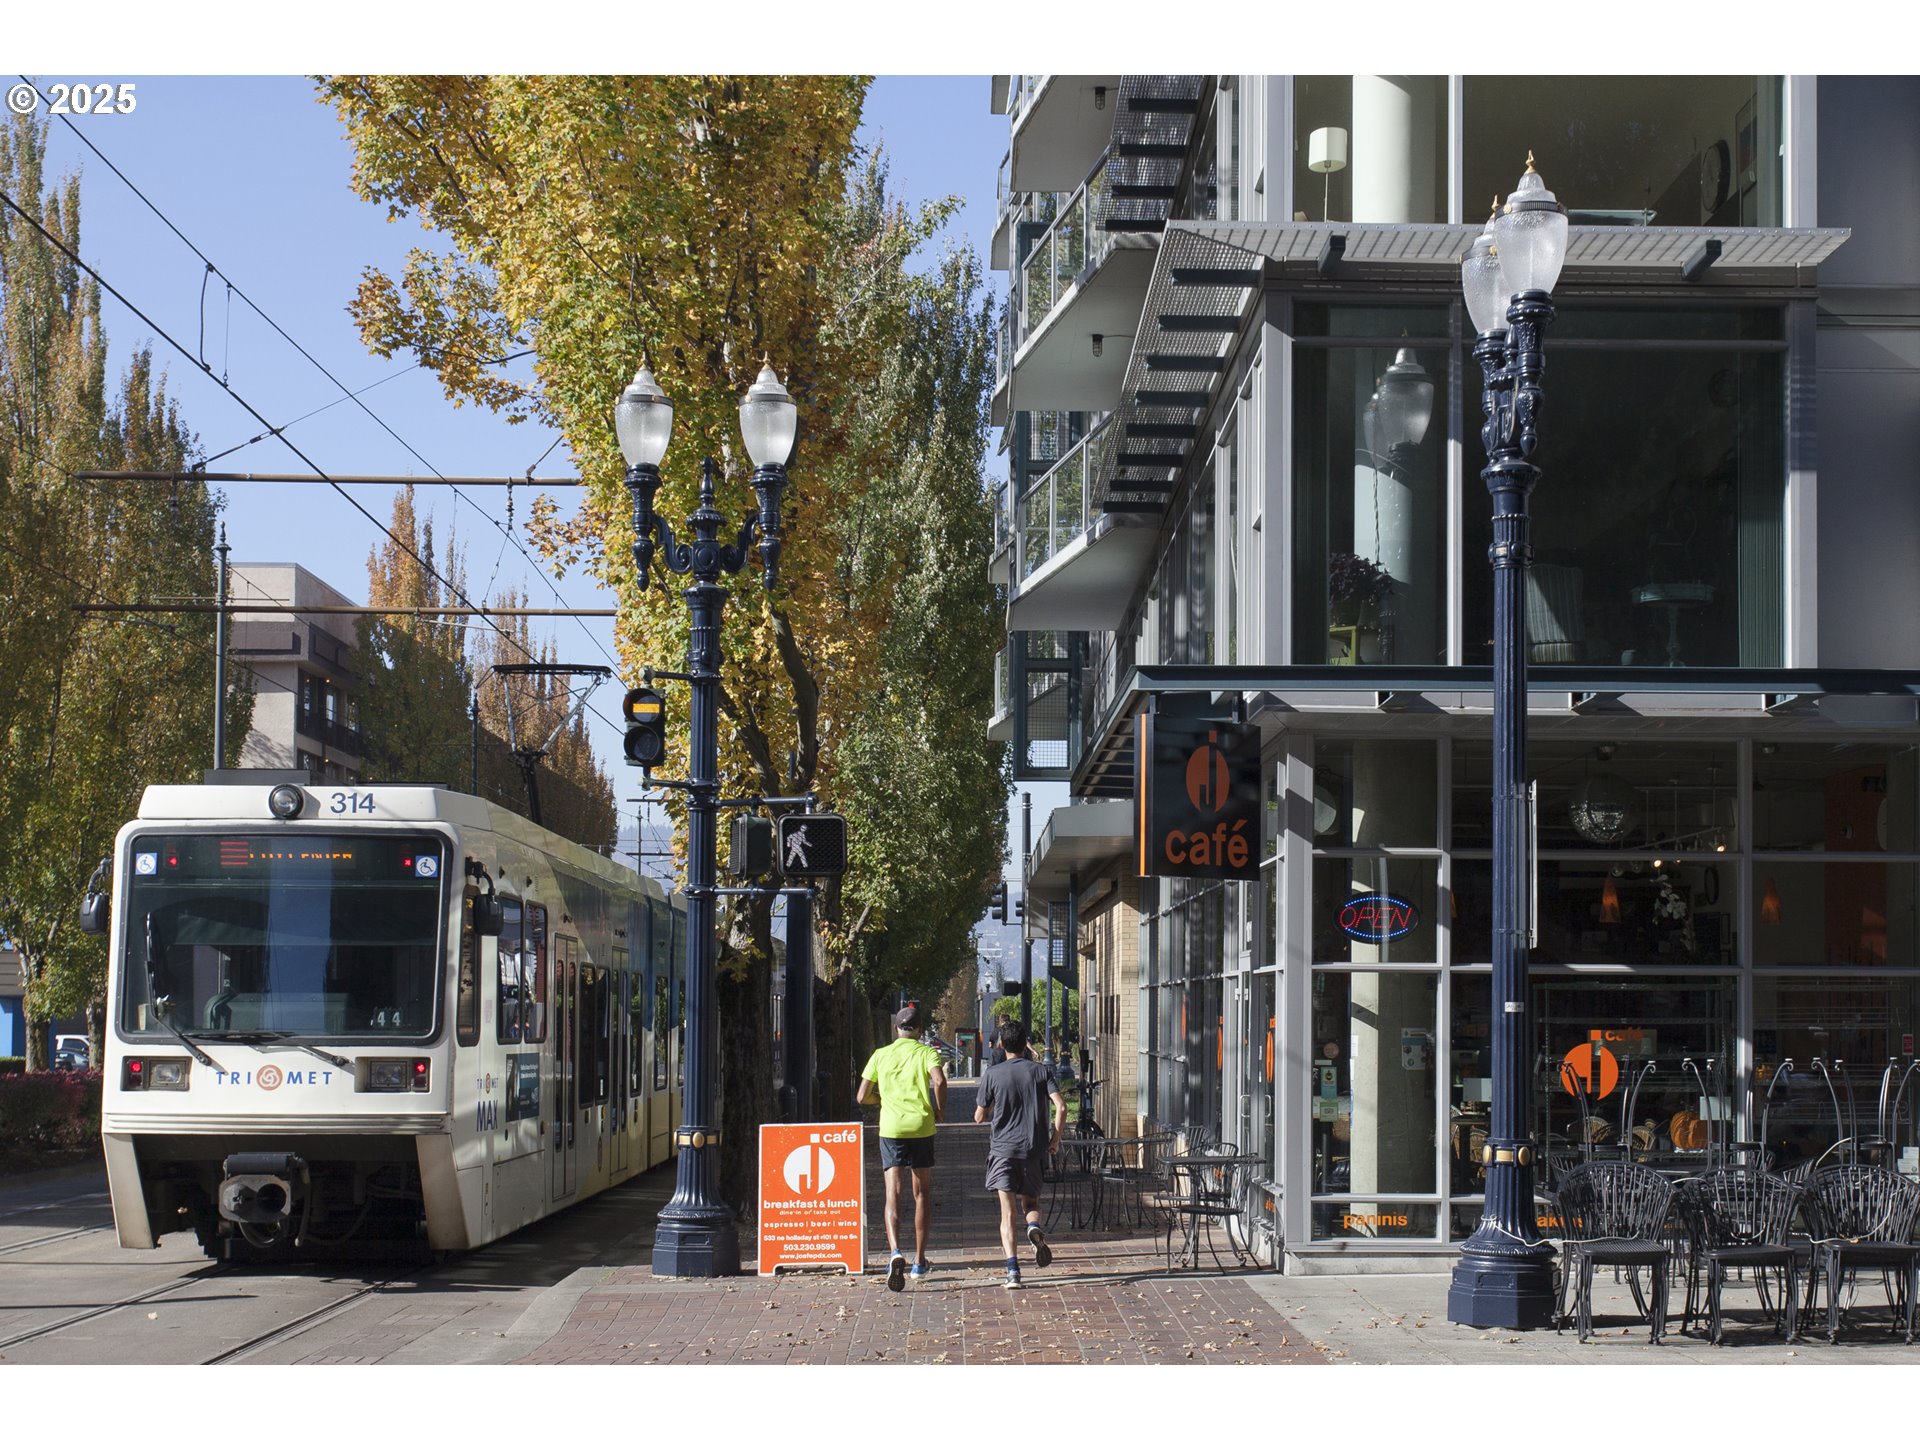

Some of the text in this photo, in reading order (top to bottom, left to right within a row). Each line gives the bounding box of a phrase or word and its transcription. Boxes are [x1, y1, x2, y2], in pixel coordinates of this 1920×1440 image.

[330, 792, 376, 814] 314
[1165, 819, 1249, 868] café
[1340, 906, 1413, 929] OPEN
[216, 1071, 333, 1085] TRI MET
[477, 1099, 498, 1132] MAX
[822, 1129, 857, 1143] café
[763, 1199, 858, 1209] breakfast & lunch
[764, 1221, 805, 1229] espresso
[1343, 1212, 1408, 1229] paninis
[783, 1243, 836, 1251] 503.230.9599
[779, 1252, 842, 1260] www.jcafepdx.com
